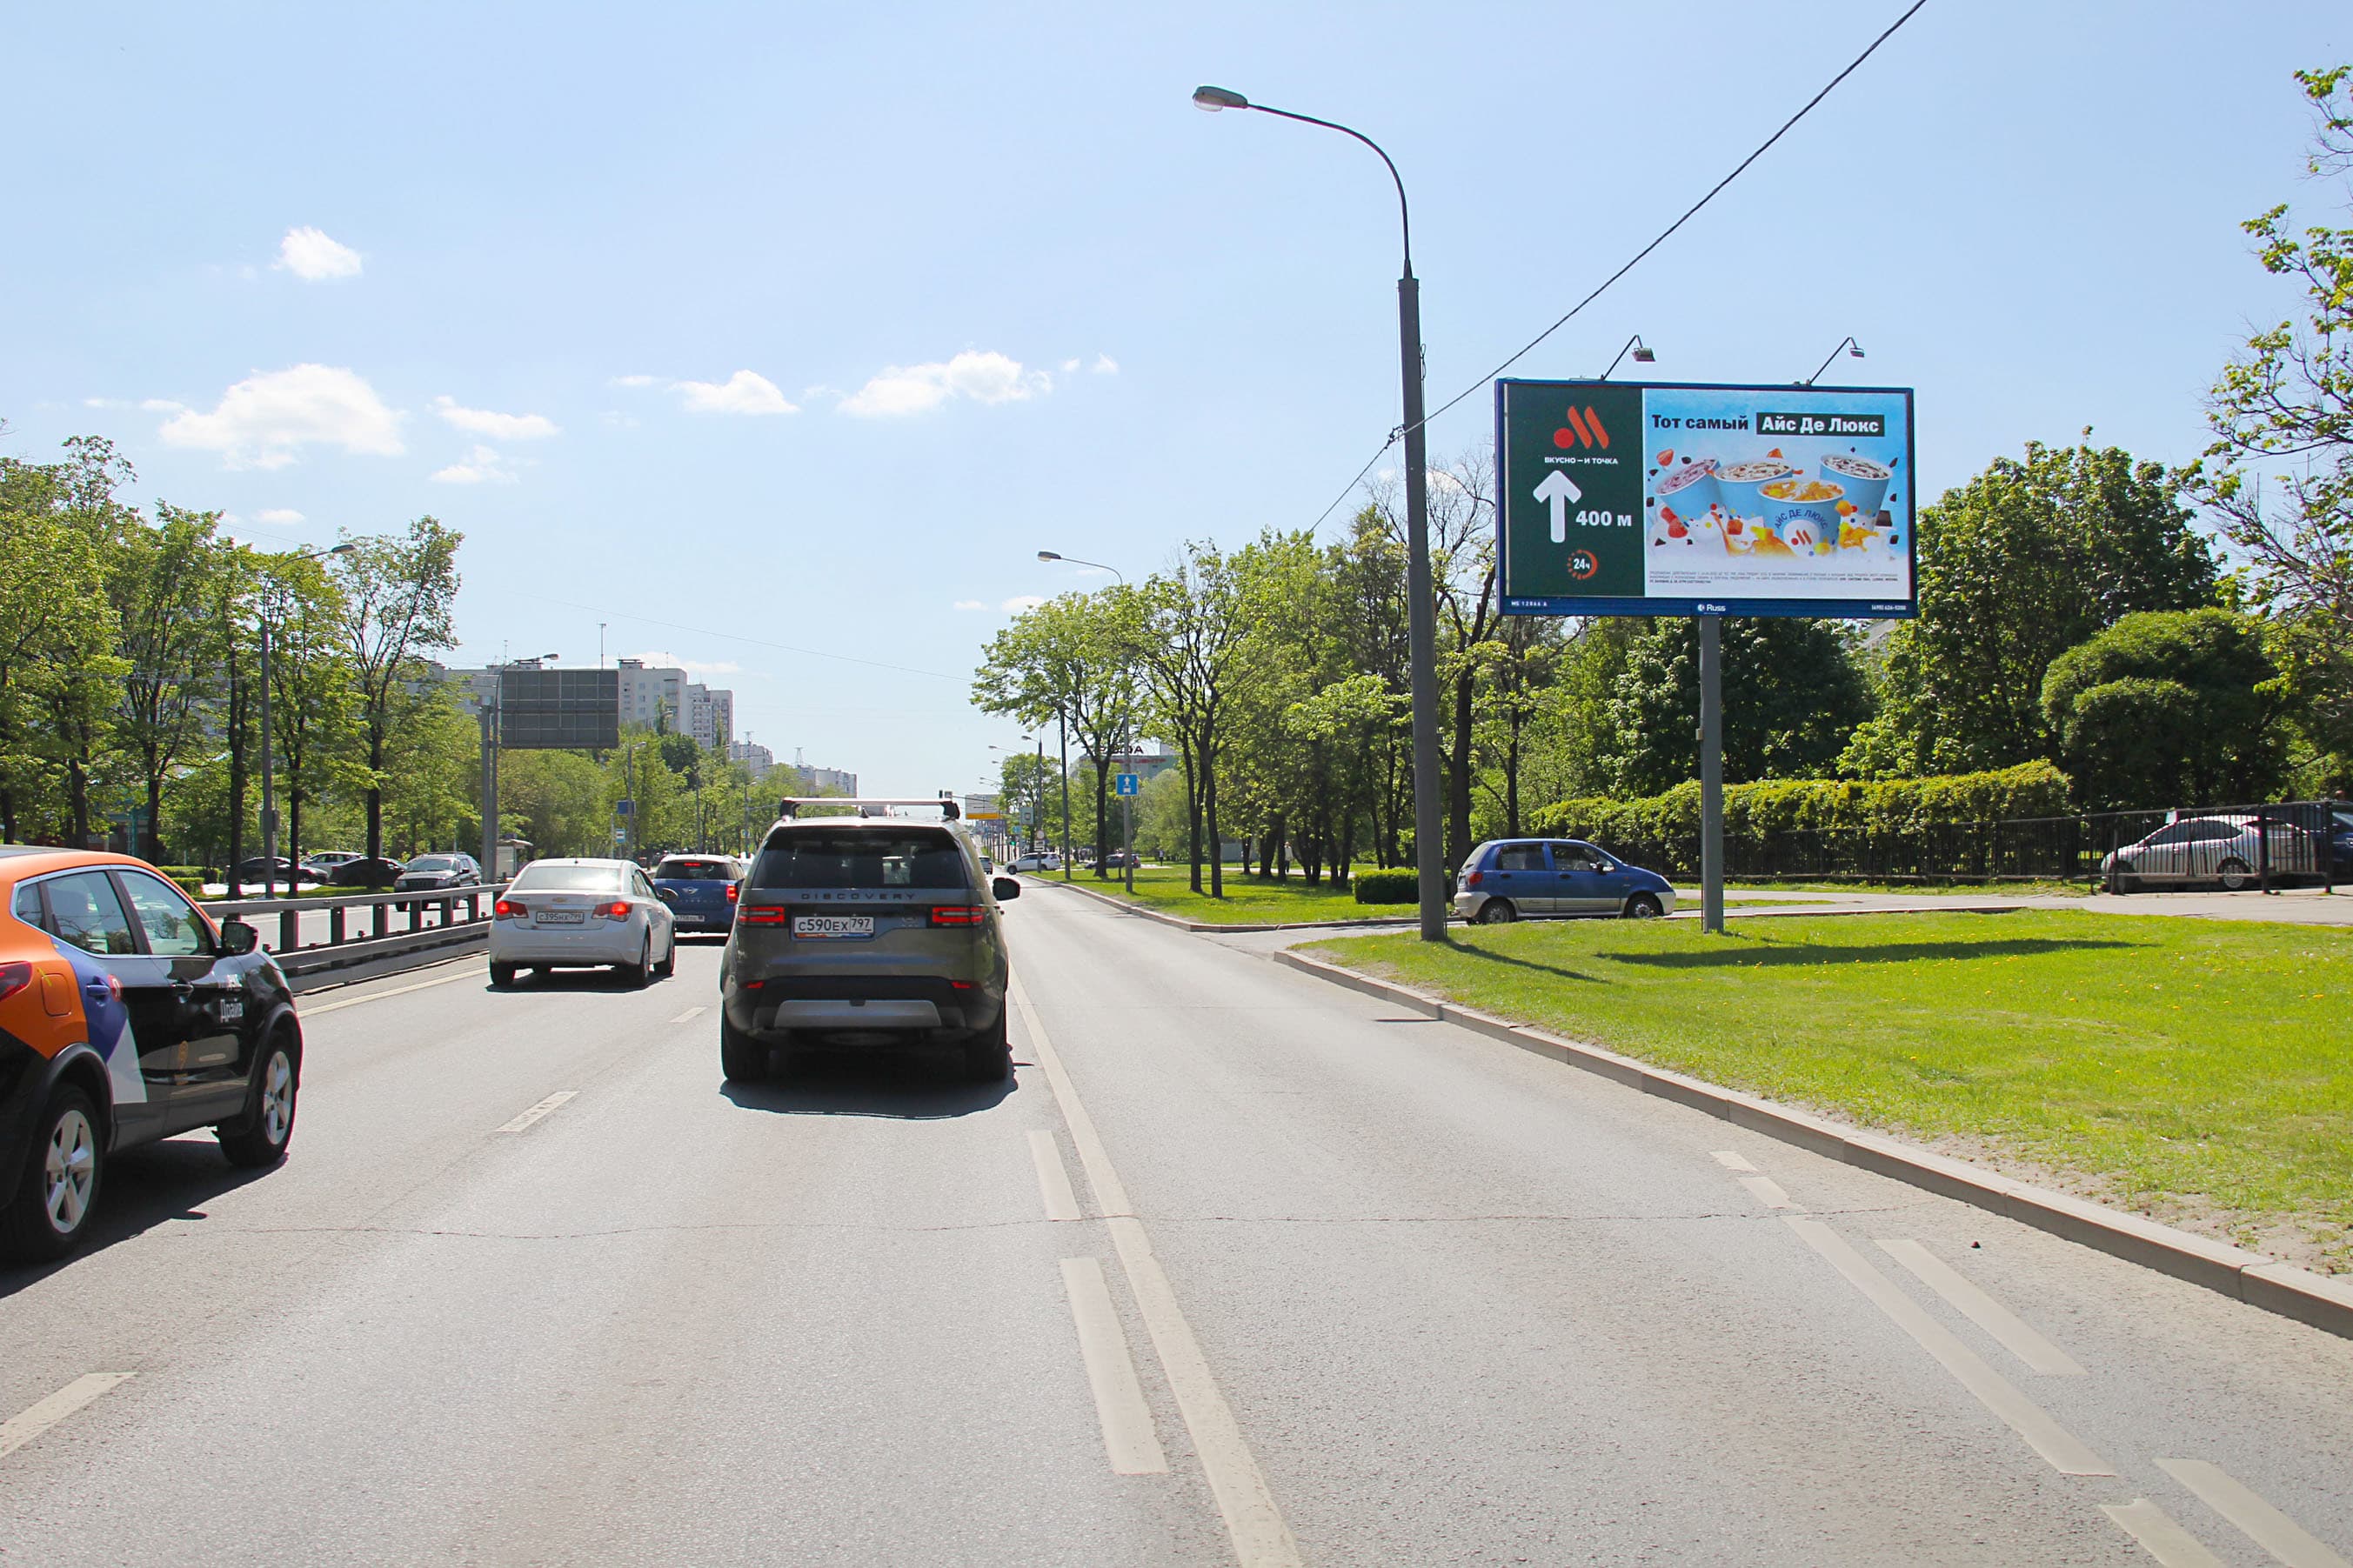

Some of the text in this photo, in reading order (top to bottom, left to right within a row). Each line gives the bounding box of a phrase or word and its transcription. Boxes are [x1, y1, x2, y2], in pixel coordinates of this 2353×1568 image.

[1651, 414, 1880, 434] Тот самый Айс Де Люкс
[1575, 510, 1613, 526] 400
[1775, 509, 1828, 529] АЙС ДЕ ЛЮКС
[851, 917, 871, 928] 797
[220, 998, 244, 1024] Драйв
